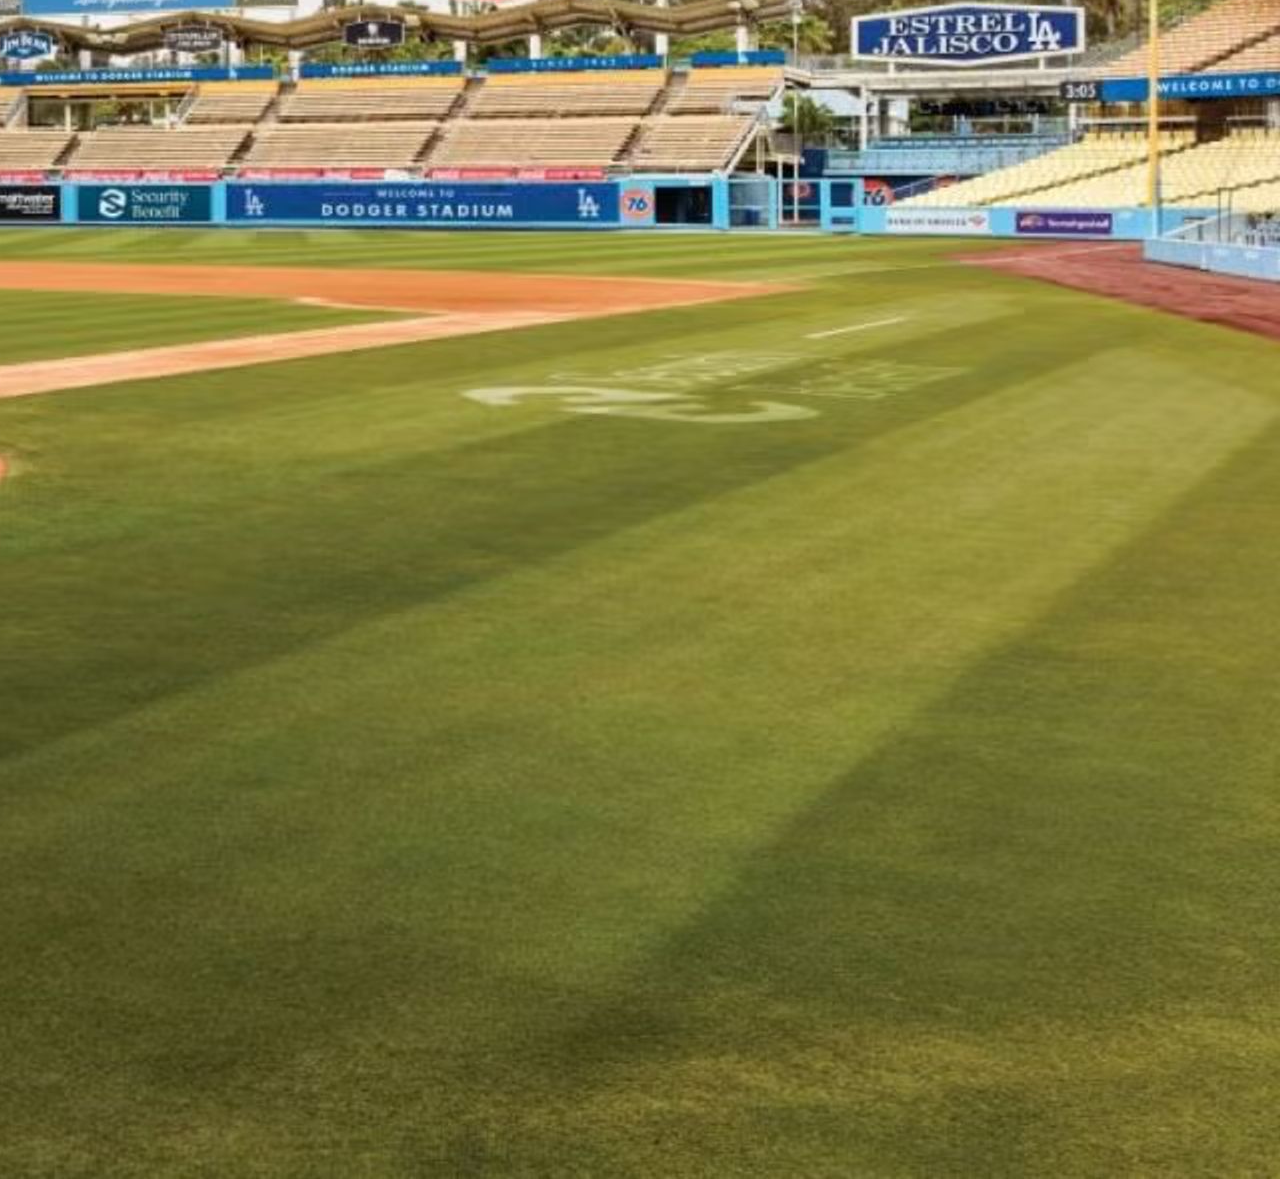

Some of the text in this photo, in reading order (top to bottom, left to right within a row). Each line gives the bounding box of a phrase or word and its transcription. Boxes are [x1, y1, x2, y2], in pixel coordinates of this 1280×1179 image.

[872, 34, 1020, 56] JALISCO
[1065, 83, 1097, 99] 3:05
[1157, 78, 1232, 93] WELCOME
[1240, 77, 1259, 89] TO
[131, 189, 189, 204] Security
[376, 188, 456, 199] WELCOME TO
[243, 188, 264, 216] LA
[576, 188, 600, 218] LA
[628, 197, 648, 213] 76
[131, 203, 181, 218] Benefit
[321, 203, 514, 218] DODGER STADIUM
